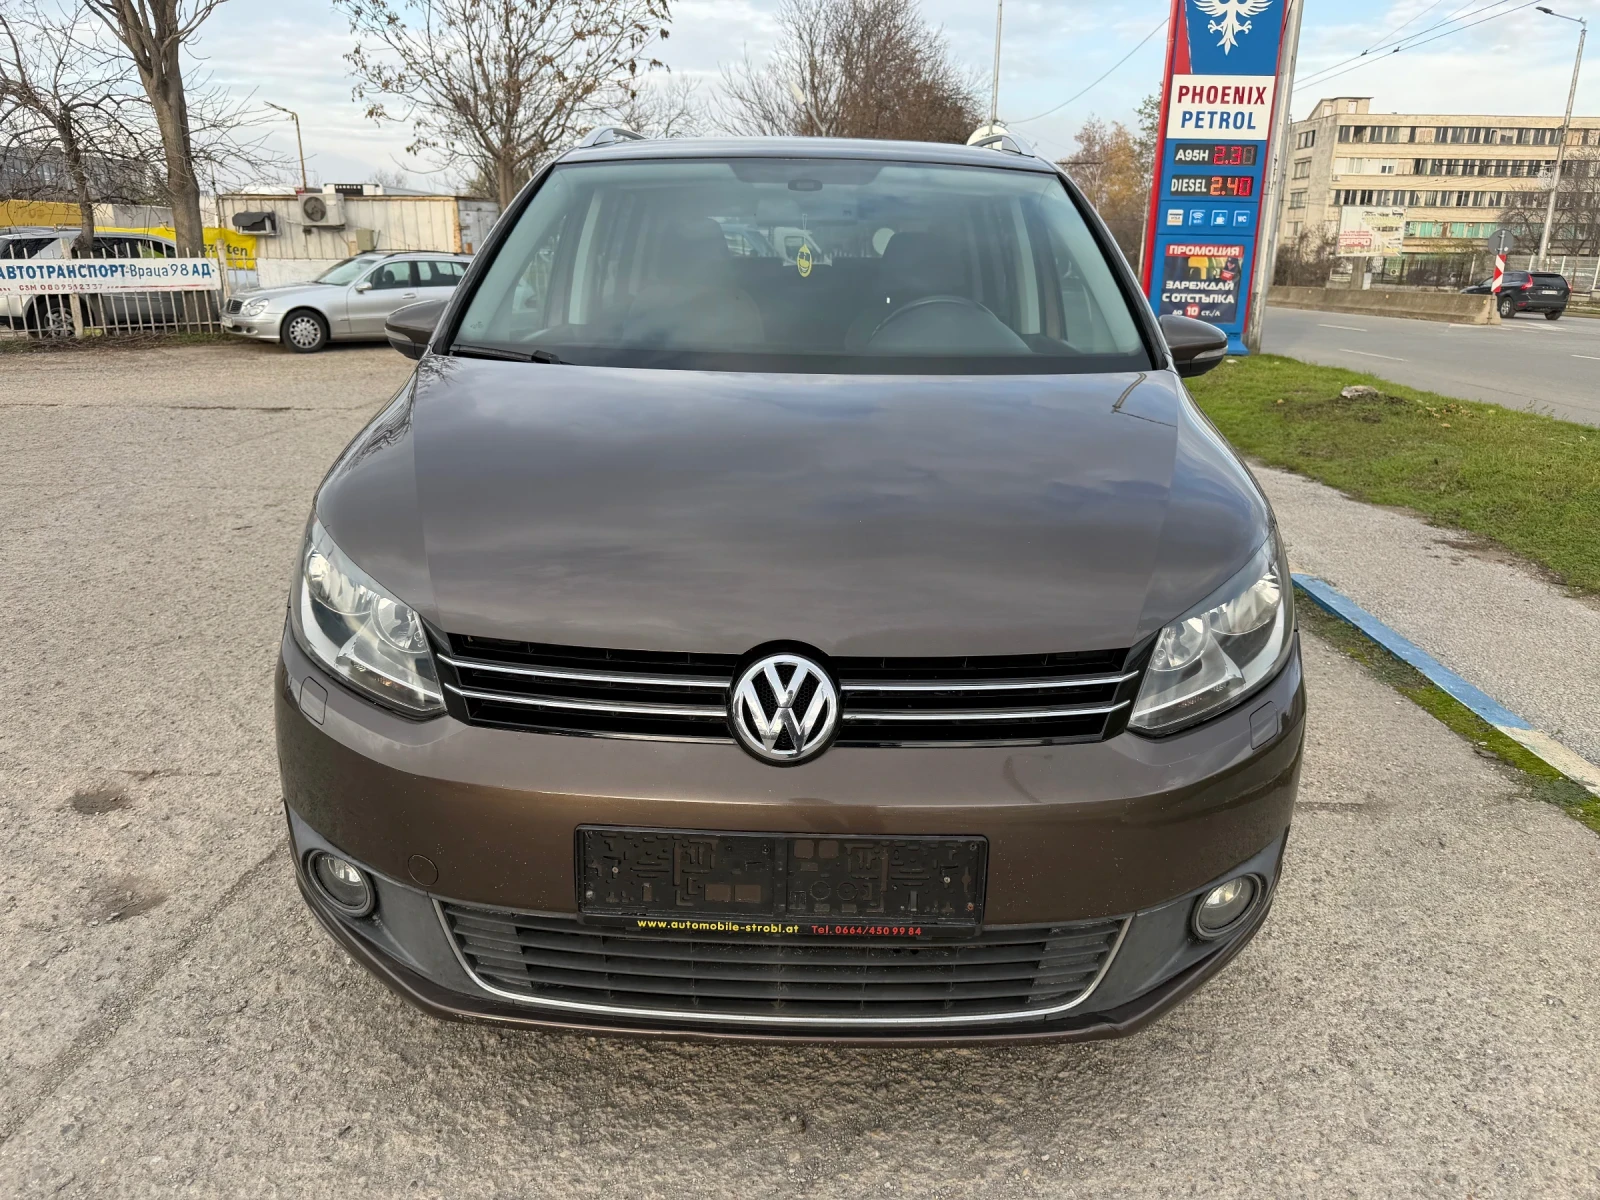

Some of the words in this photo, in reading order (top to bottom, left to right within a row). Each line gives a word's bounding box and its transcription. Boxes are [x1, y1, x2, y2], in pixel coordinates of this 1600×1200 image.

[1177, 85, 1267, 105] PHOENIX
[1181, 110, 1256, 130] PETROL
[1175, 149, 1209, 161] A95H
[1170, 178, 1207, 192] DIESEL
[1210, 176, 1252, 196] 2.40
[1169, 245, 1240, 256] ПРОМОЦИЯ
[1165, 280, 1235, 291] ЗАРЕЖДАЙ
[1162, 293, 1170, 302] С
[1171, 293, 1235, 304] ОТСТЪПКА
[1187, 306, 1199, 316] 10
[637, 920, 799, 934] www.automobile-strobl.at
[811, 925, 833, 934] Tel.
